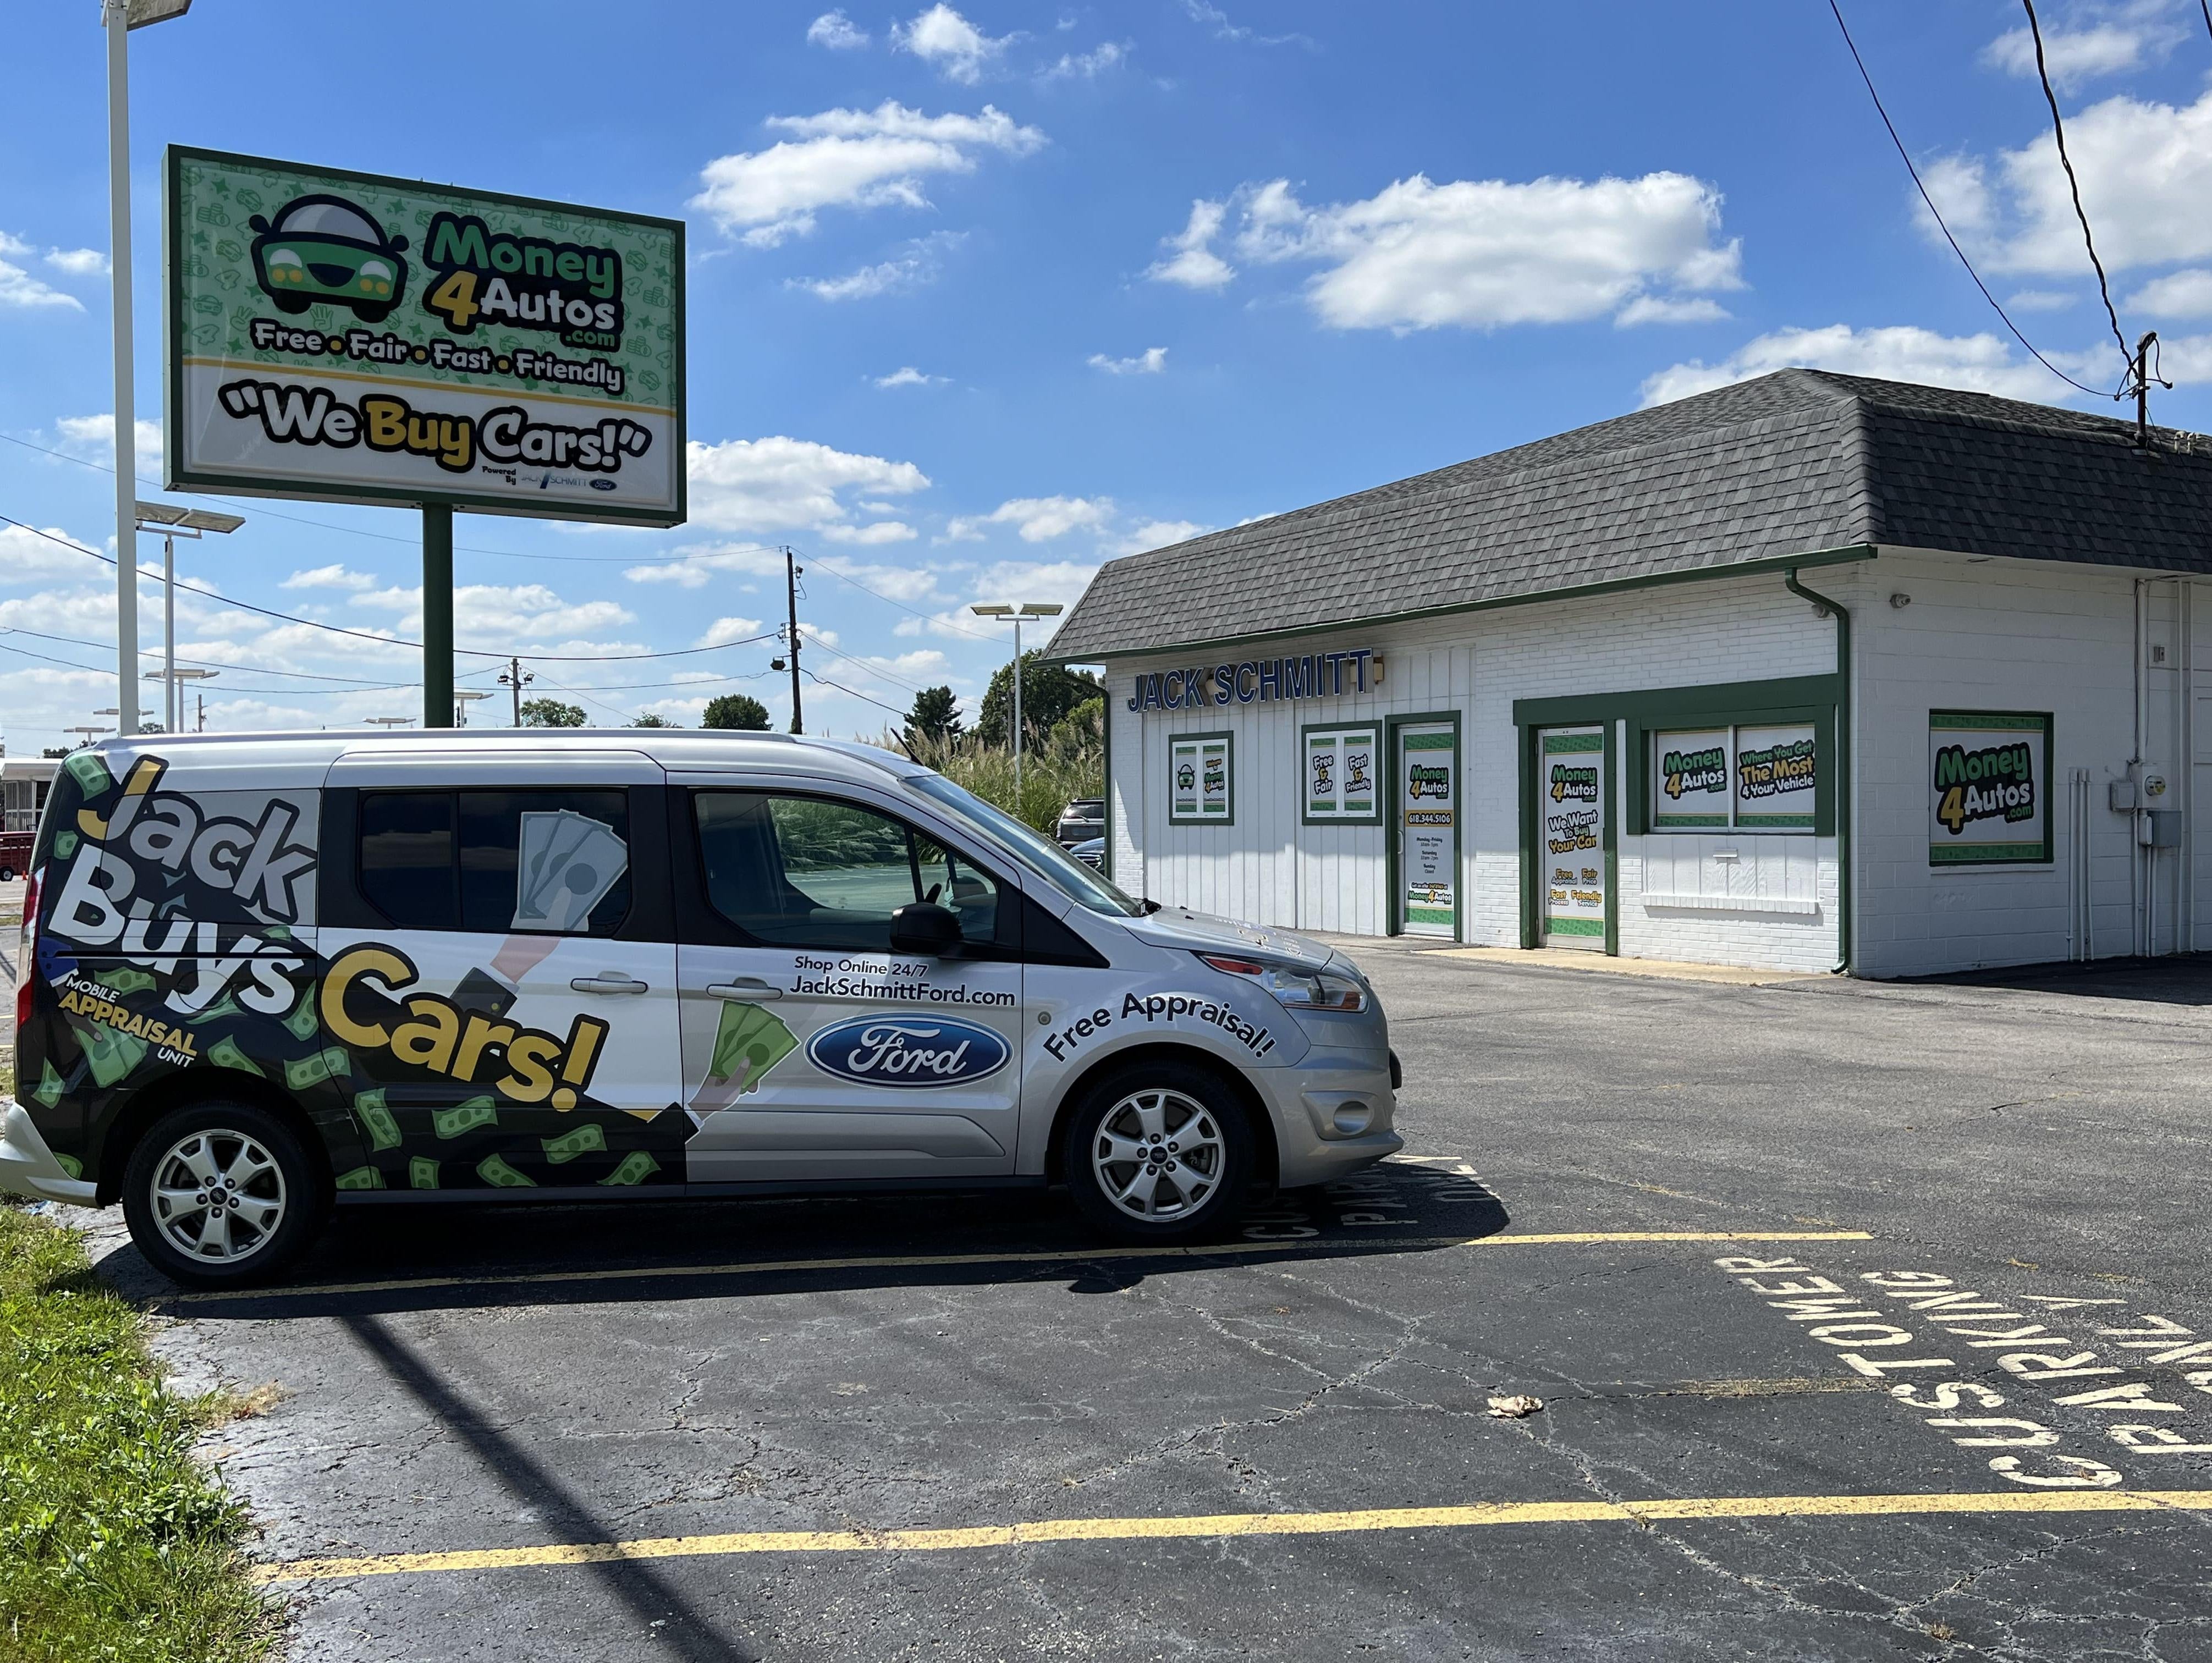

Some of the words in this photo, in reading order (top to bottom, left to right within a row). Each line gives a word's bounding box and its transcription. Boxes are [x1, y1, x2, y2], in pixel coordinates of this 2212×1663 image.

[431, 221, 614, 299] Money
[431, 270, 615, 329] 4Autos
[565, 330, 615, 347] .com
[255, 323, 323, 351] Free
[350, 333, 407, 360] Fair
[433, 343, 491, 370] Fast
[516, 353, 620, 392] Friendly
[365, 401, 470, 466] Buy
[482, 466, 516, 476] Powered
[505, 476, 516, 485] By
[549, 475, 587, 487] SCHMITT
[1127, 667, 1205, 713] JACK
[1213, 647, 1373, 707] SCHMITT
[1313, 756, 1334, 769] Free
[1349, 755, 1368, 770] Fast
[1665, 750, 1723, 774] Money
[1741, 751, 1773, 766] Where
[1774, 747, 1793, 759] You
[1794, 742, 1813, 755] Get
[1411, 766, 1448, 783] Money
[1552, 766, 1596, 784] Money
[1741, 765, 1770, 785] The
[1773, 756, 1814, 779] Most
[1938, 747, 2029, 786] Money
[1314, 779, 1333, 793] Fair
[1345, 778, 1371, 792] Friendly
[1708, 783, 1726, 792] .com
[1742, 785, 1749, 797] 4
[1750, 783, 1775, 796] Your
[1775, 774, 1814, 791] Vehicle
[1408, 814, 1451, 823] 618.344.5106
[1548, 816, 1567, 831] We
[1567, 810, 1598, 828] Want
[2006, 806, 2032, 819] .com
[76, 759, 317, 915] Jack
[1564, 828, 1573, 838] To
[1573, 825, 1589, 837] Buy
[1549, 839, 1575, 853] Your
[1556, 868, 1573, 879] Free
[1582, 868, 1597, 878] Fair
[1548, 897, 1569, 906] Process
[1551, 889, 1566, 899] Fast
[1571, 890, 1602, 903] Friendly
[48, 843, 305, 1015] Buys
[794, 956, 833, 973] Shop
[839, 959, 888, 974] Online
[892, 963, 928, 977] 24/7
[65, 976, 120, 1003] MOBILE
[790, 975, 1015, 1006] JackSchmittFord.com
[58, 990, 197, 1056] APPRAISAL
[321, 949, 602, 1113] Cars!
[1042, 1006, 1111, 1062] Free
[1121, 992, 1276, 1059] Appraisal!
[157, 1047, 195, 1068] UNIT
[848, 1024, 971, 1075] Ford
[2020, 1293, 2212, 1395] NLY
[1713, 1256, 2123, 1488] CUSTOMER
[1859, 1269, 2212, 1454] PARKING
